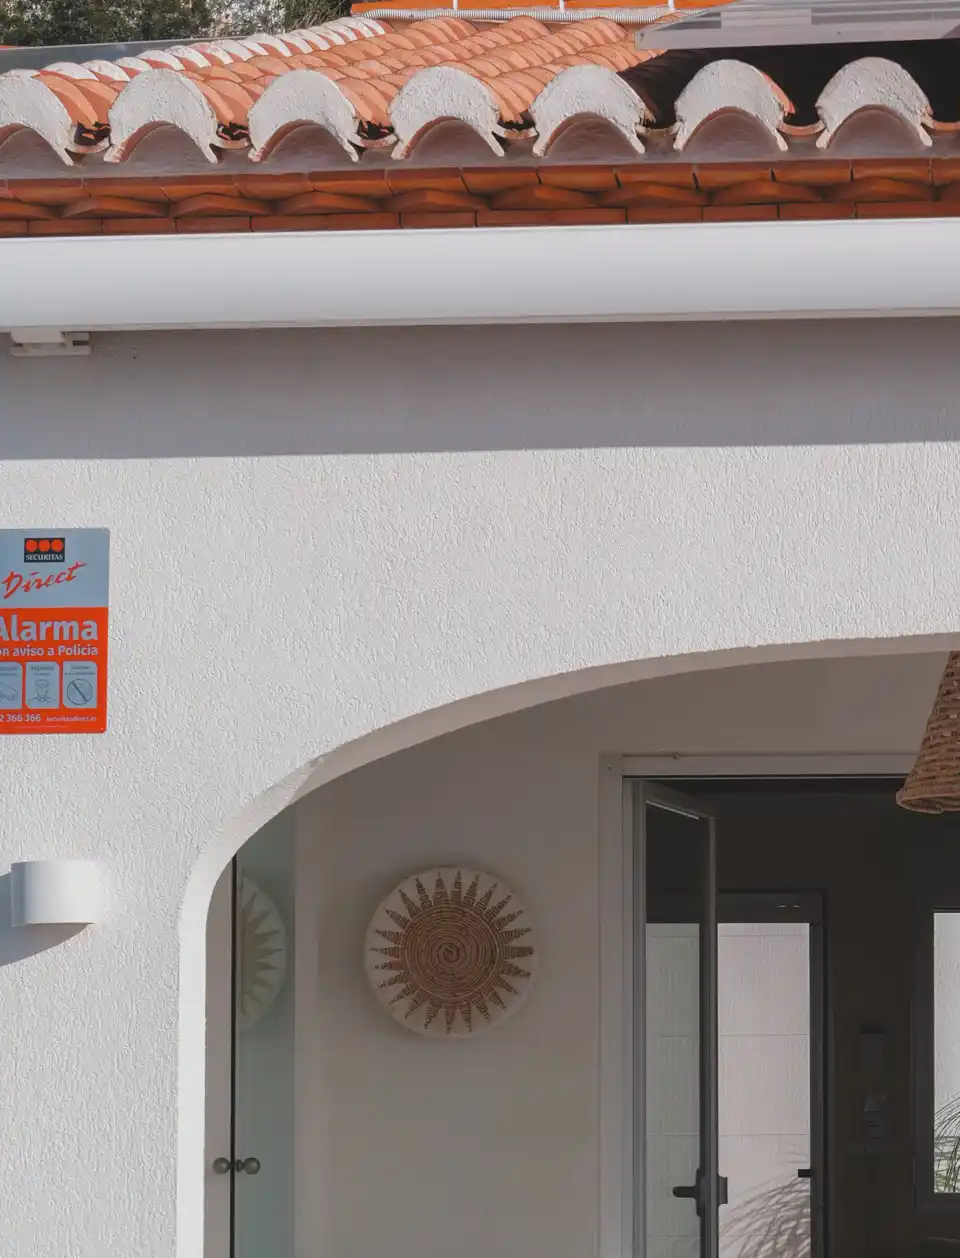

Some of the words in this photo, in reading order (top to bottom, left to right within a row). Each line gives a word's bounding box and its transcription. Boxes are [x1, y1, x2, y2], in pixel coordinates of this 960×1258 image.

[25, 553, 64, 561] SECURITAS
[1, 561, 88, 599] Direct
[13, 644, 44, 656] aviso
[47, 647, 55, 656] a
[25, 713, 41, 722] 366
